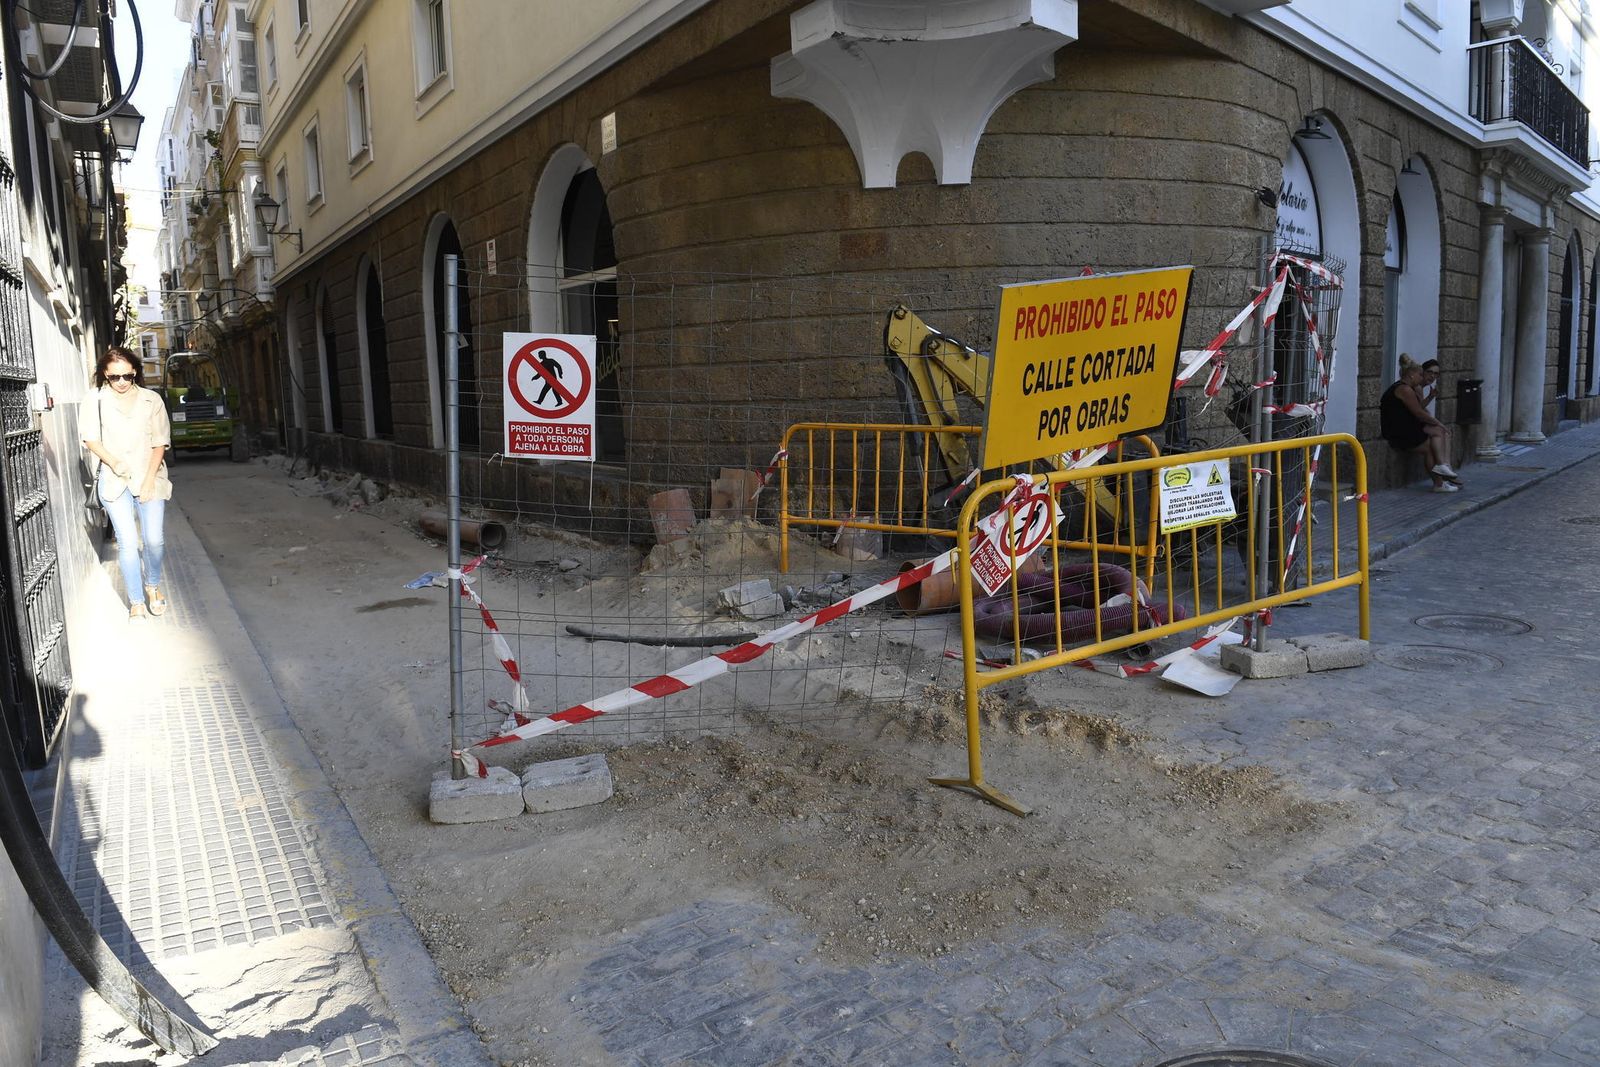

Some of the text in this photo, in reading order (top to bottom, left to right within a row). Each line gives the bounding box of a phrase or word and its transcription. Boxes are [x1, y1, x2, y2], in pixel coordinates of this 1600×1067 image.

[1014, 287, 1178, 341] PROHIBIDO EL PASO
[1022, 343, 1156, 396] CALLE CORTADA
[1037, 393, 1131, 441] POR OBRAS
[510, 424, 589, 436] PROHIBIDO EL PASO
[523, 434, 544, 442] TODA
[546, 436, 584, 444] PERSONA
[514, 443, 540, 451] AJENA
[549, 444, 559, 452] LA
[561, 445, 584, 453] OBRA
[1168, 501, 1187, 510] ESTAMOS
[1188, 497, 1213, 507] TRABAJANDO
[1169, 495, 1192, 504] DISCULPEN
[1200, 490, 1223, 499] MOLESTIAS
[1167, 507, 1186, 516] MEJORAR
[1195, 500, 1226, 510] INSTALACIONES
[1164, 515, 1184, 524] RESPETEN
[977, 549, 992, 568] PASAR
[992, 568, 1003, 583] LOS
[986, 544, 1007, 574] PROHIBIDO
[973, 559, 995, 587] PEATONES
